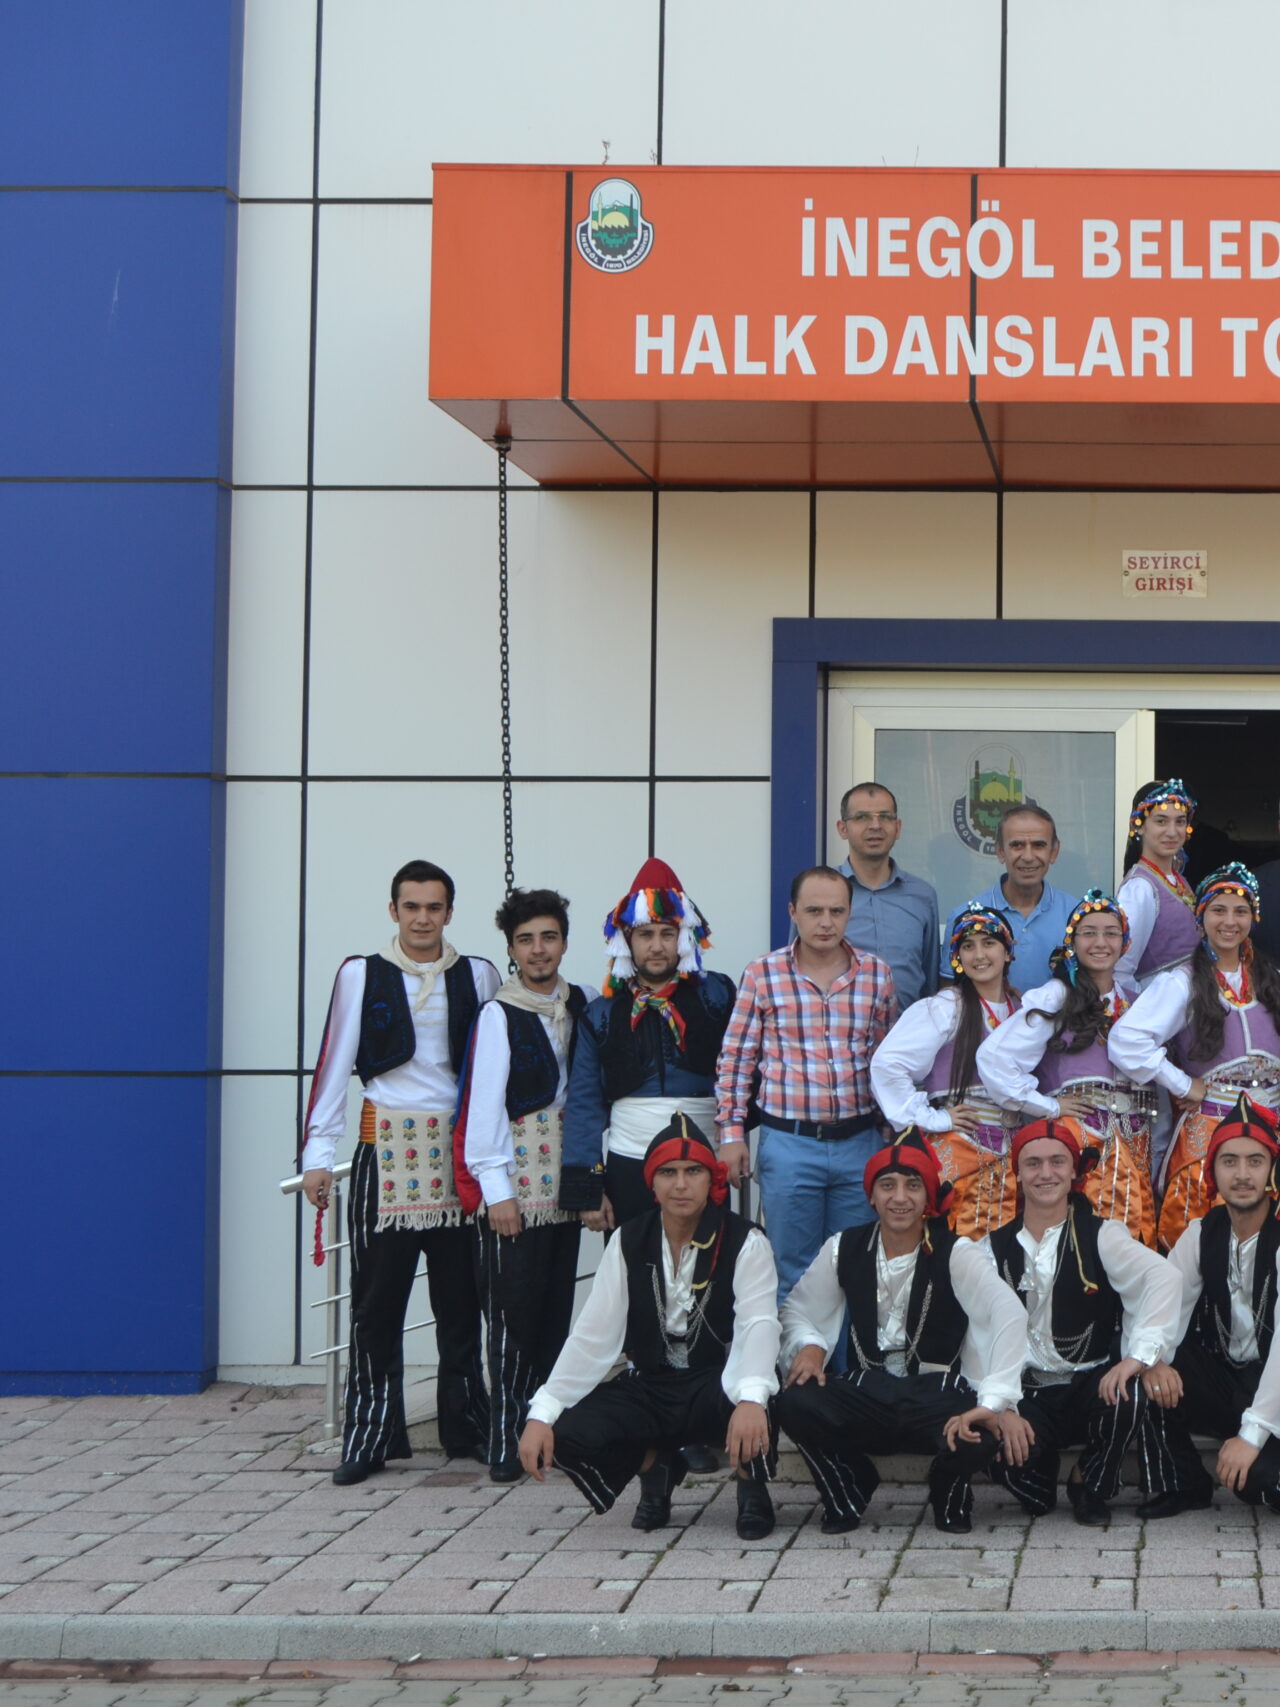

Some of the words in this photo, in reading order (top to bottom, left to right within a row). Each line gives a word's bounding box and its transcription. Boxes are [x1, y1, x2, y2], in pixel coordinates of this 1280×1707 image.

[802, 198, 1054, 280] İNEGÖL
[635, 314, 817, 376] HALK
[844, 315, 1194, 378] DANSLARI
[1127, 552, 1201, 570] SEYİRCİ
[1135, 574, 1194, 595] GİRİŞİ
